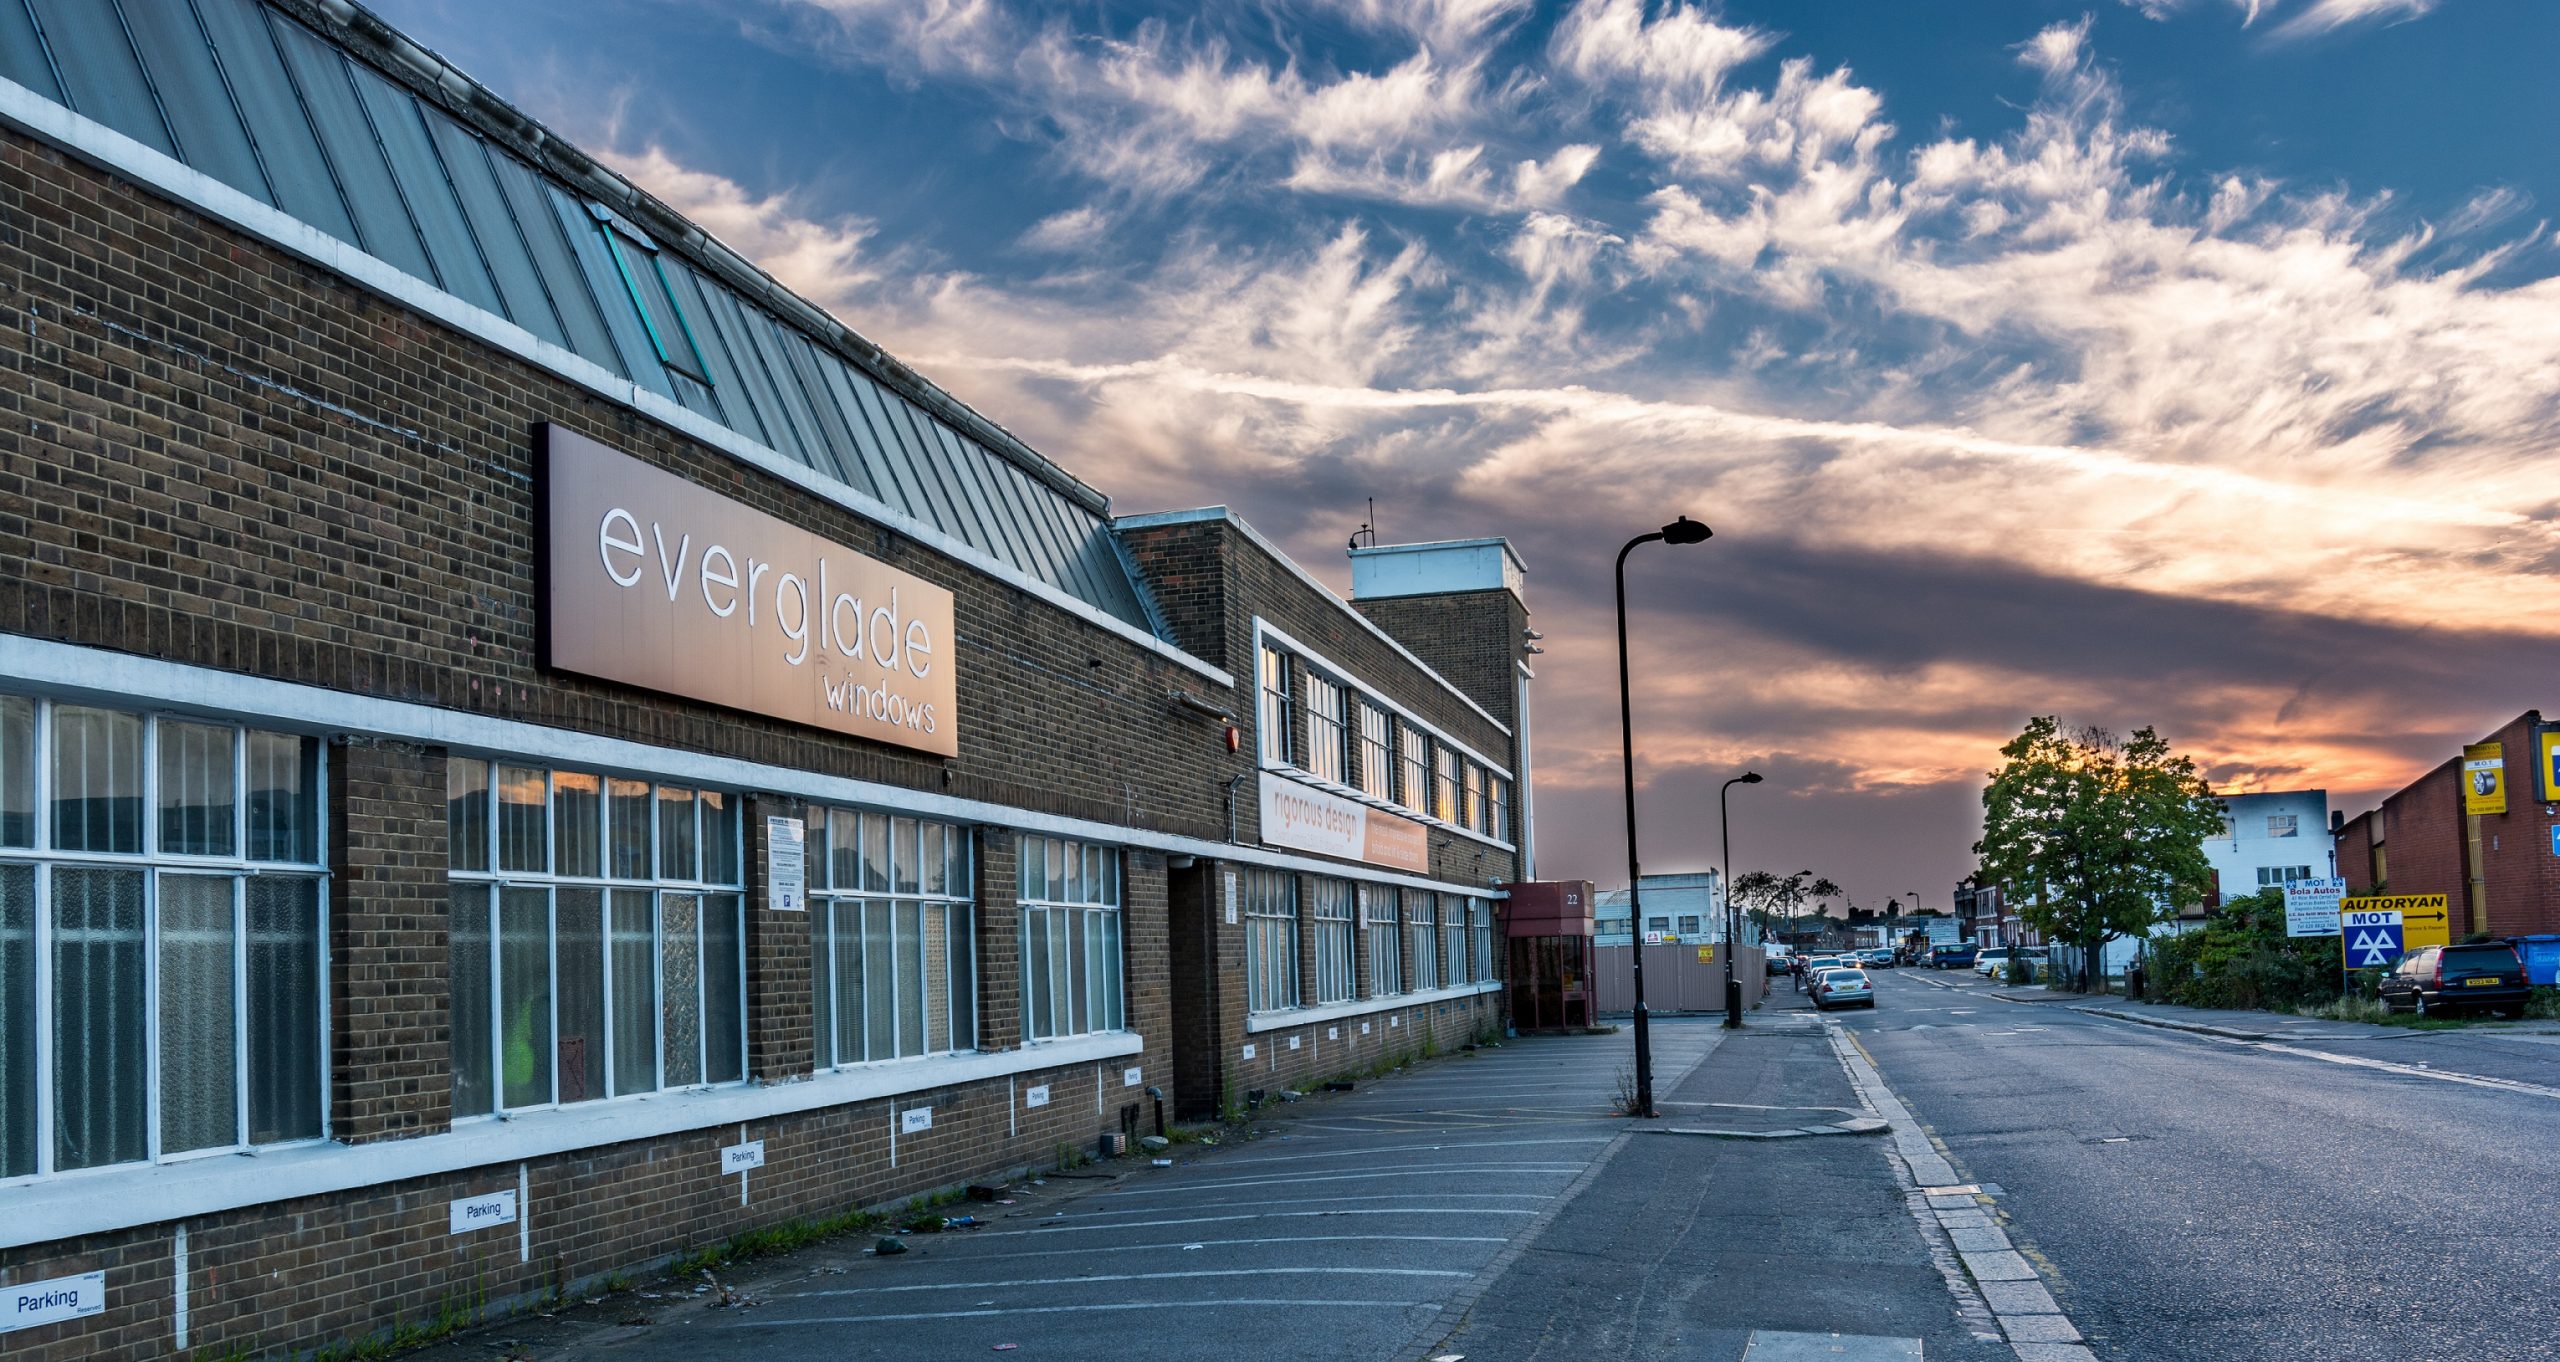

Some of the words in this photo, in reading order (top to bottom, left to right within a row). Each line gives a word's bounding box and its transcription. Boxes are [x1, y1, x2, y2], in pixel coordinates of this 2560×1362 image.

[600, 507, 932, 679] everglade
[822, 672, 935, 734] windows
[1274, 783, 1322, 829] rigorous
[1325, 800, 1357, 843] design
[2305, 879, 2325, 887] MOT
[2290, 888, 2311, 896] Bola
[2313, 887, 2341, 895] Autos
[1567, 894, 1578, 905] 22
[2343, 896, 2444, 911] AUTORYAN
[2352, 911, 2393, 925] MOT
[732, 1150, 755, 1163] Parking
[466, 1202, 501, 1219] Parking
[18, 1290, 78, 1313] Parking
[77, 1304, 102, 1313] Reserved
